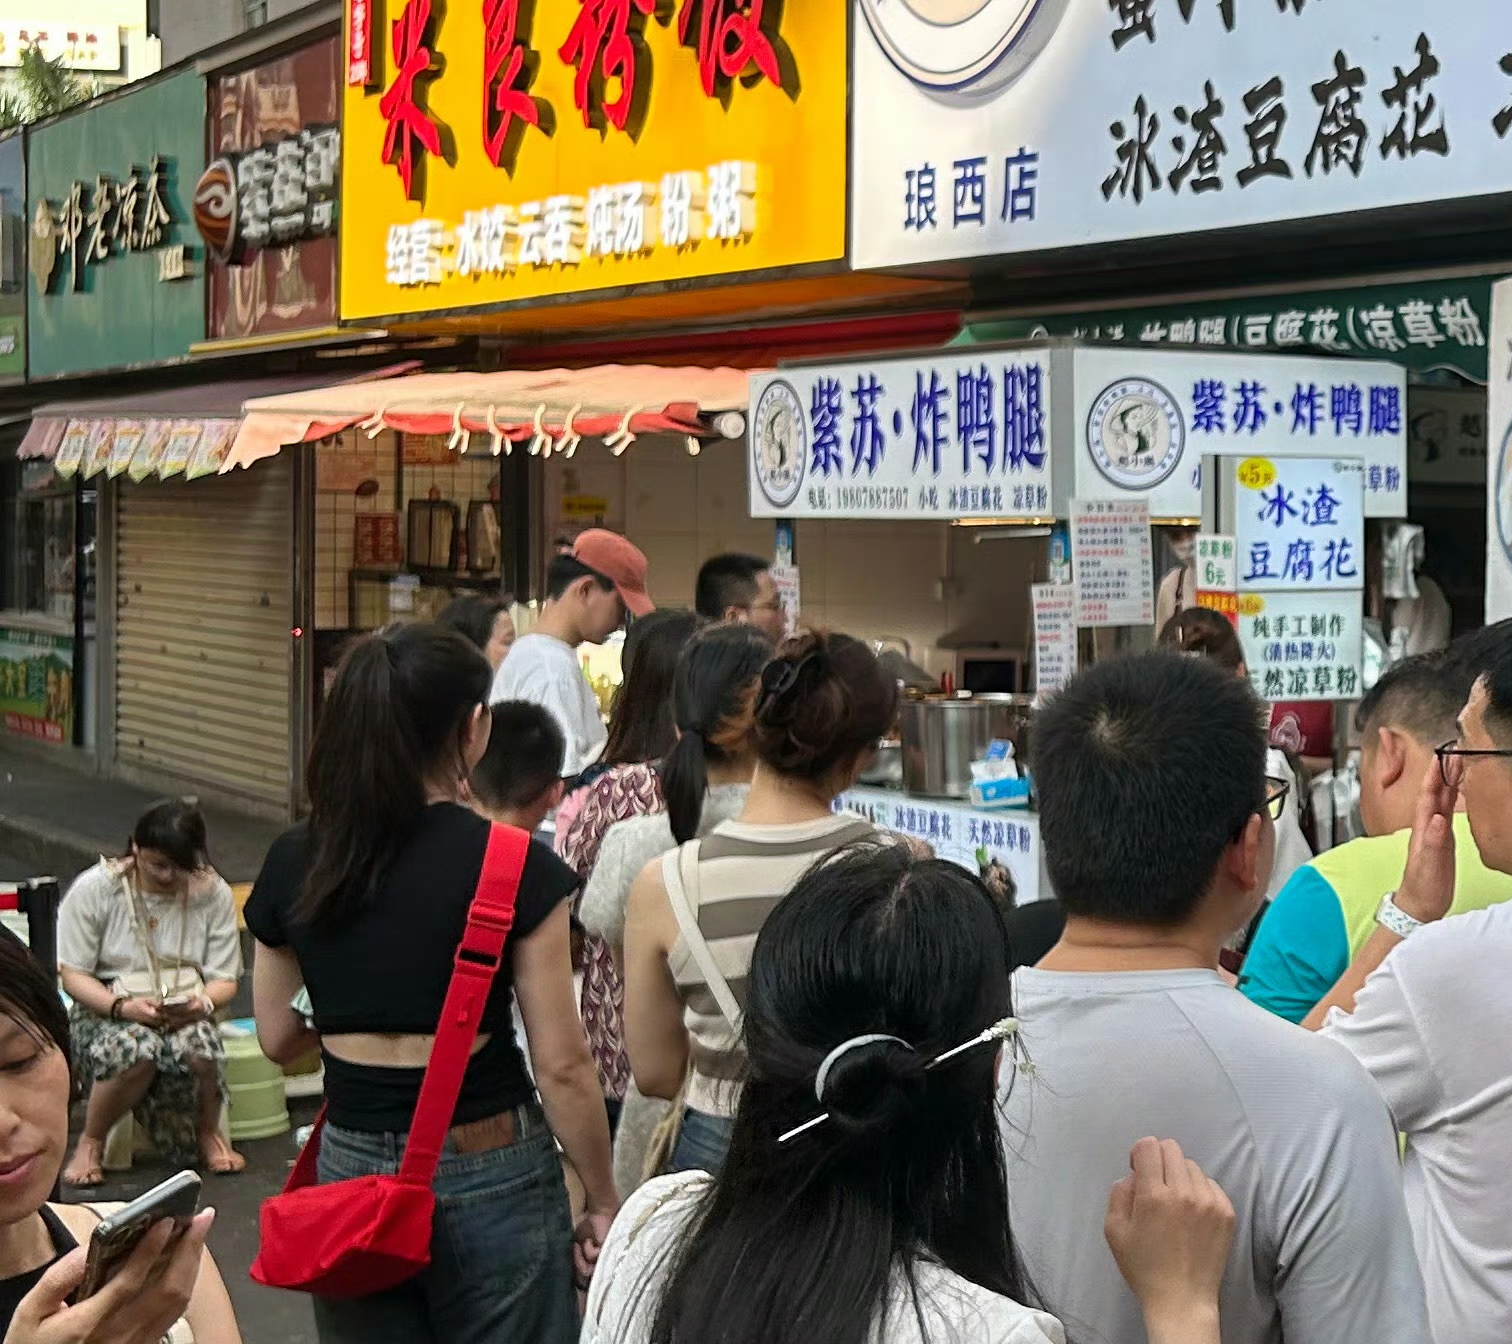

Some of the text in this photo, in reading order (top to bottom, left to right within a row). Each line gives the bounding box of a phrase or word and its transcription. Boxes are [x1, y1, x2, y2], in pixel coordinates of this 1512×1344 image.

[1101, 33, 1447, 205] 冰渣豆腐花
[903, 148, 1039, 232] 琅西店
[810, 362, 1048, 478] 紫苏·炸鸭腿
[1191, 379, 1401, 437] 紫苏·炸鸭腿
[1361, 463, 1401, 494] 草粉
[1258, 482, 1342, 527] 冰渣
[1243, 537, 1358, 582] 豆腐花
[1253, 613, 1346, 638] 纯手工制作
